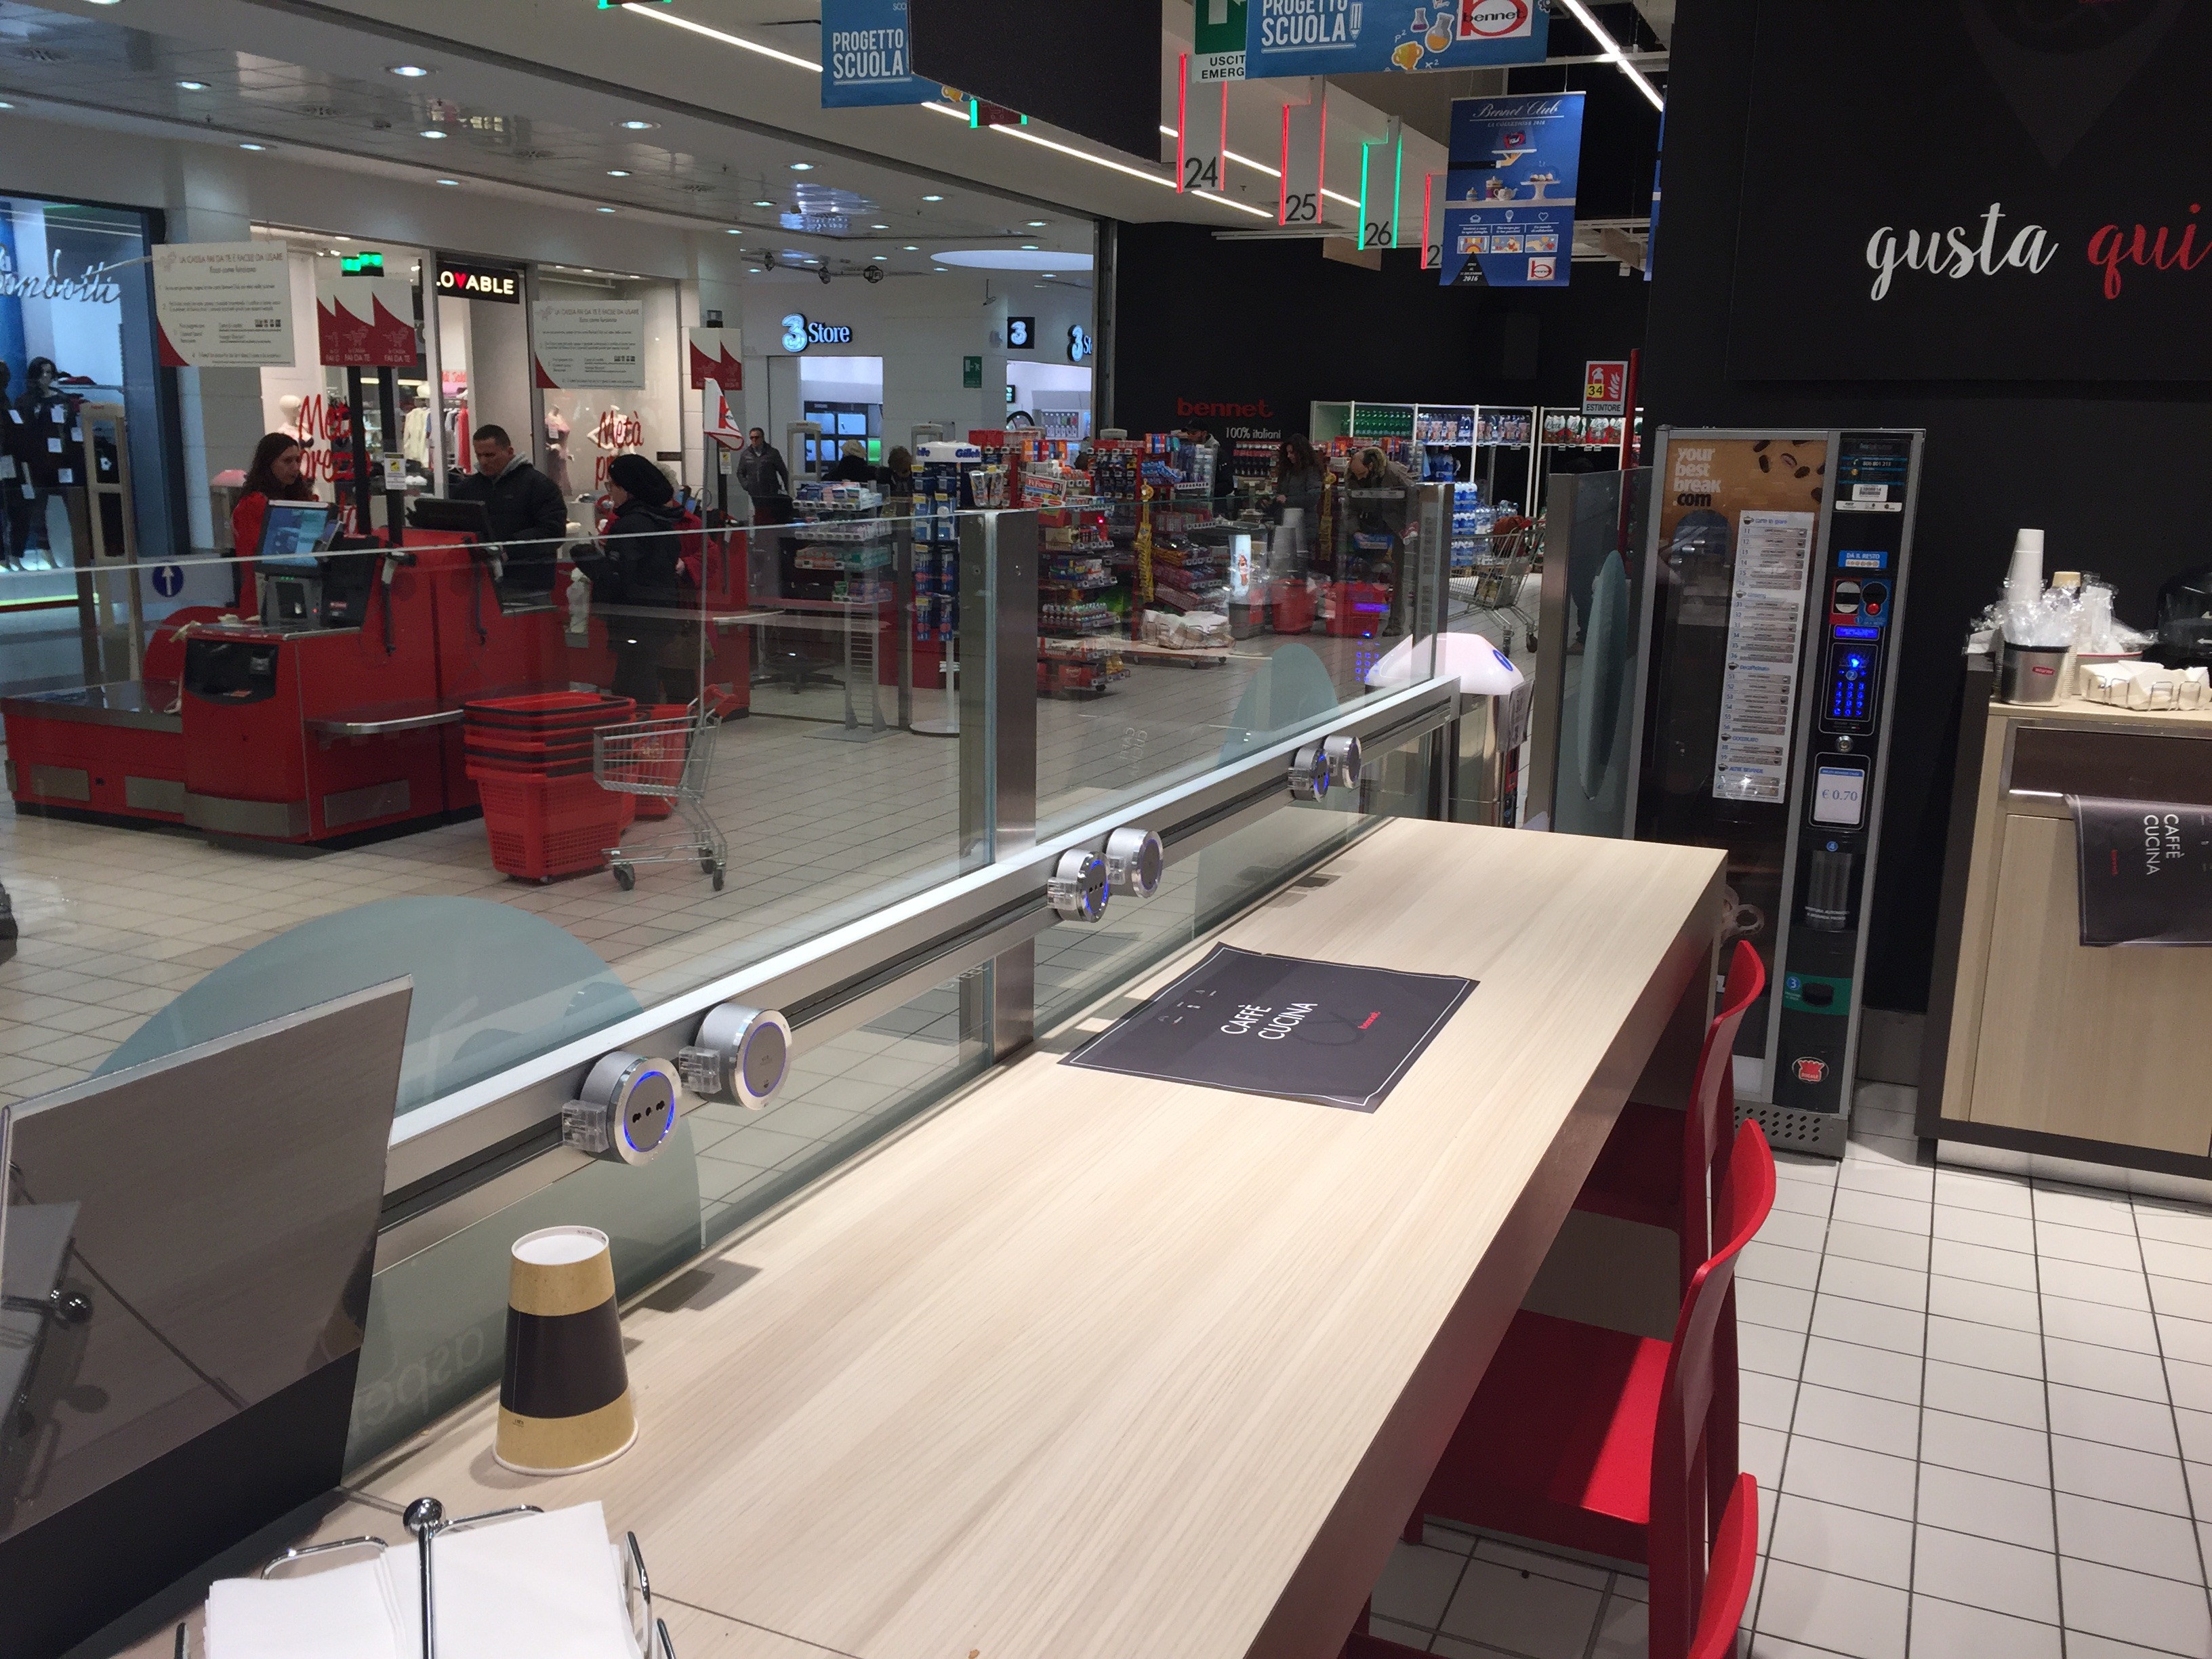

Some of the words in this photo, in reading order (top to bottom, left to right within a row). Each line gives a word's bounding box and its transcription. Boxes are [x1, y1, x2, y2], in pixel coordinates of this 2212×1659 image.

[1462, 9, 1528, 22] bennet
[832, 28, 904, 52] PROGETTO
[1261, 13, 1346, 46] SCUOLA
[833, 50, 903, 79] SCUOLA
[1210, 55, 1246, 66] USCIT
[1202, 67, 1244, 79] EMERG
[1473, 103, 1523, 117] Bennet
[1527, 100, 1562, 115] Club
[1185, 157, 1218, 189] 24
[1285, 194, 1317, 222] 25
[1364, 221, 1392, 247] 26
[1427, 245, 1442, 266] 2
[1866, 202, 2060, 301] gusta
[2087, 203, 2212, 300] qui
[436, 270, 514, 295] OVABLE
[781, 314, 807, 352] 3
[808, 323, 850, 343] Store
[1010, 321, 1027, 345] 3
[1071, 325, 1083, 361] 3
[1084, 335, 1092, 354] St
[1588, 386, 1603, 396] 34
[1176, 397, 1274, 418] bennet
[1586, 403, 1621, 411] ESTINTORE
[598, 410, 644, 449] Metà
[1226, 427, 1250, 439] 100%
[1252, 428, 1282, 439] italiani
[1677, 448, 1716, 464] your
[1675, 462, 1711, 476] best
[1673, 477, 1721, 493] break
[1673, 493, 1712, 507] .com
[1822, 790, 1829, 798] €
[1832, 790, 1858, 801] 0.70
[2144, 815, 2160, 875] CUCINA
[2164, 814, 2185, 859] CAFFÈ
[1221, 1004, 1272, 1035] CAFFÈ
[1258, 1003, 1318, 1040] CUCINA
